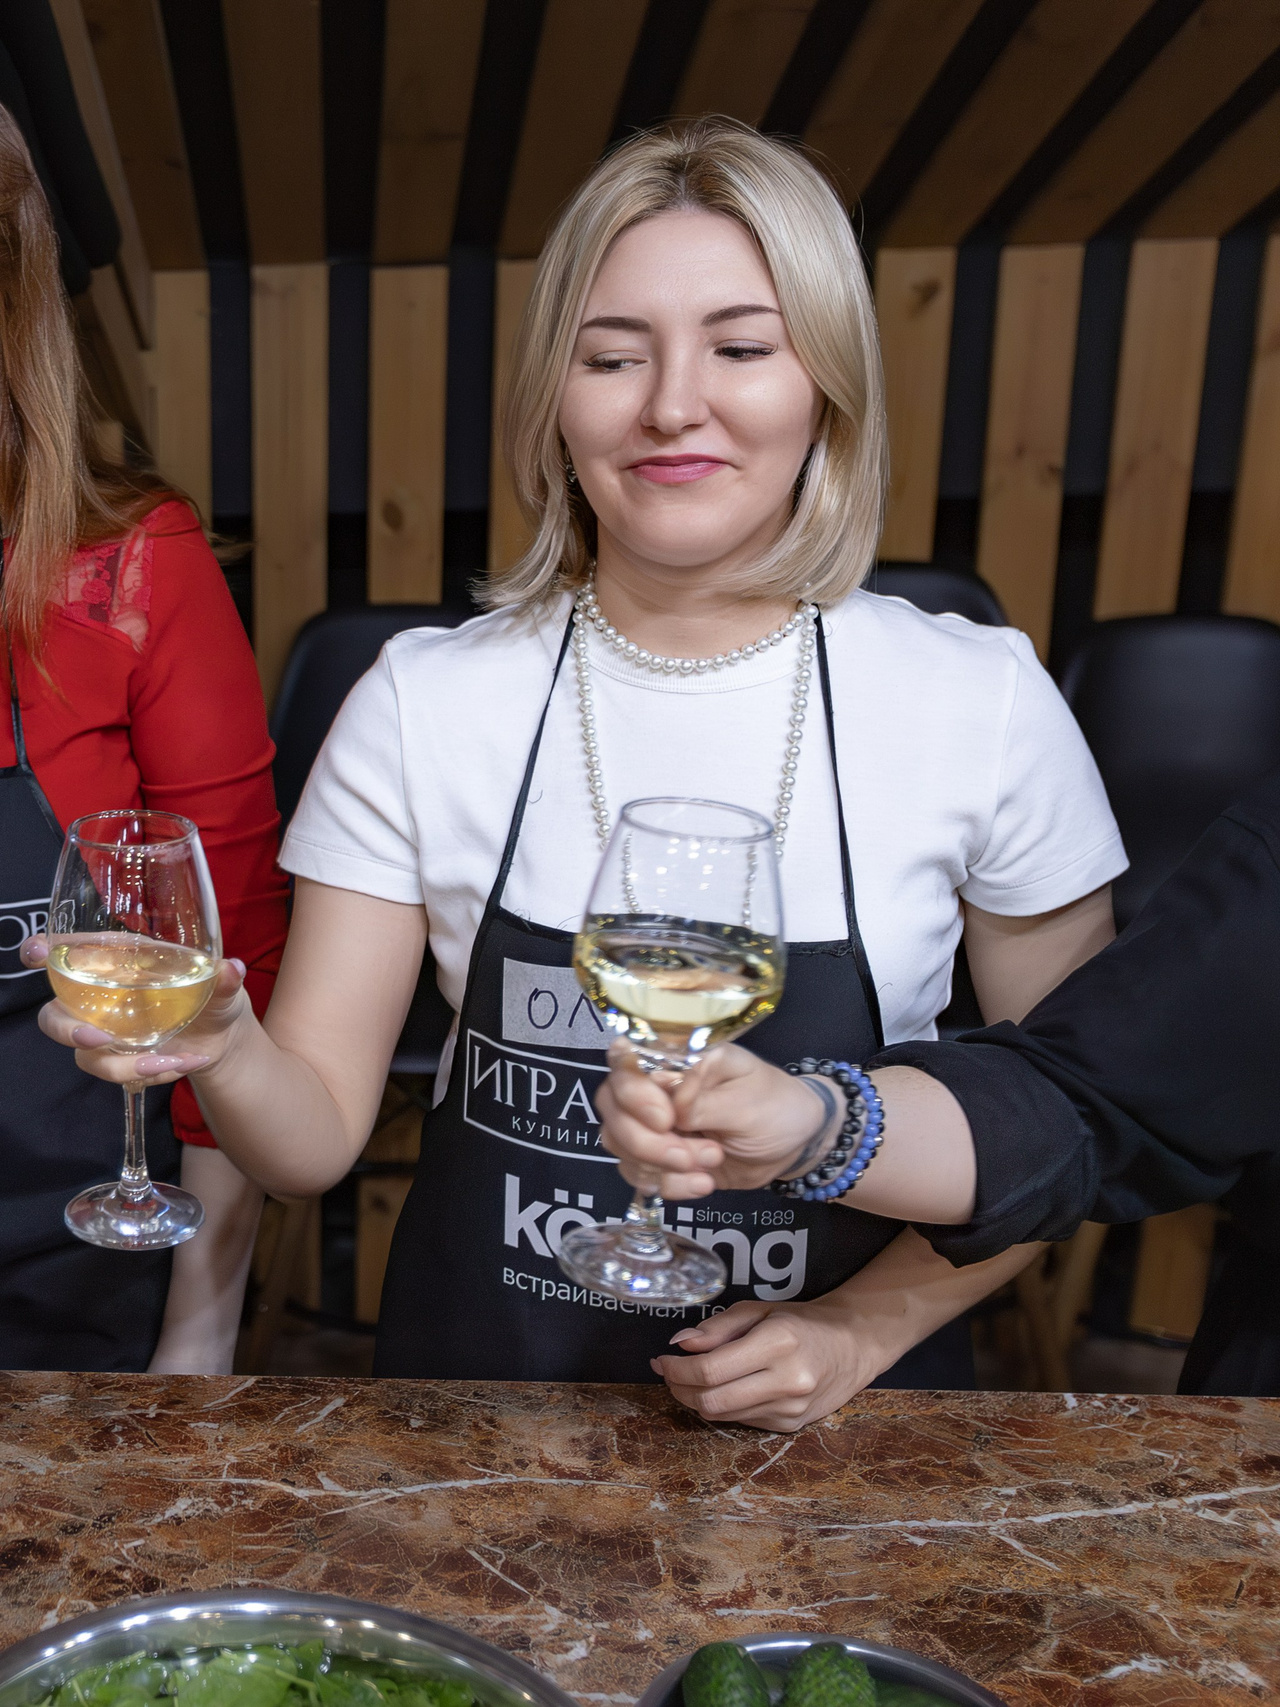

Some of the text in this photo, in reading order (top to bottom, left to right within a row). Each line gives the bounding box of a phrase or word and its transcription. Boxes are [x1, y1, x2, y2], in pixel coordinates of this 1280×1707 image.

[473, 1044, 601, 1126] ИГРА
[696, 1206, 795, 1226] since 1889
[503, 1266, 686, 1320] встраиваемая
